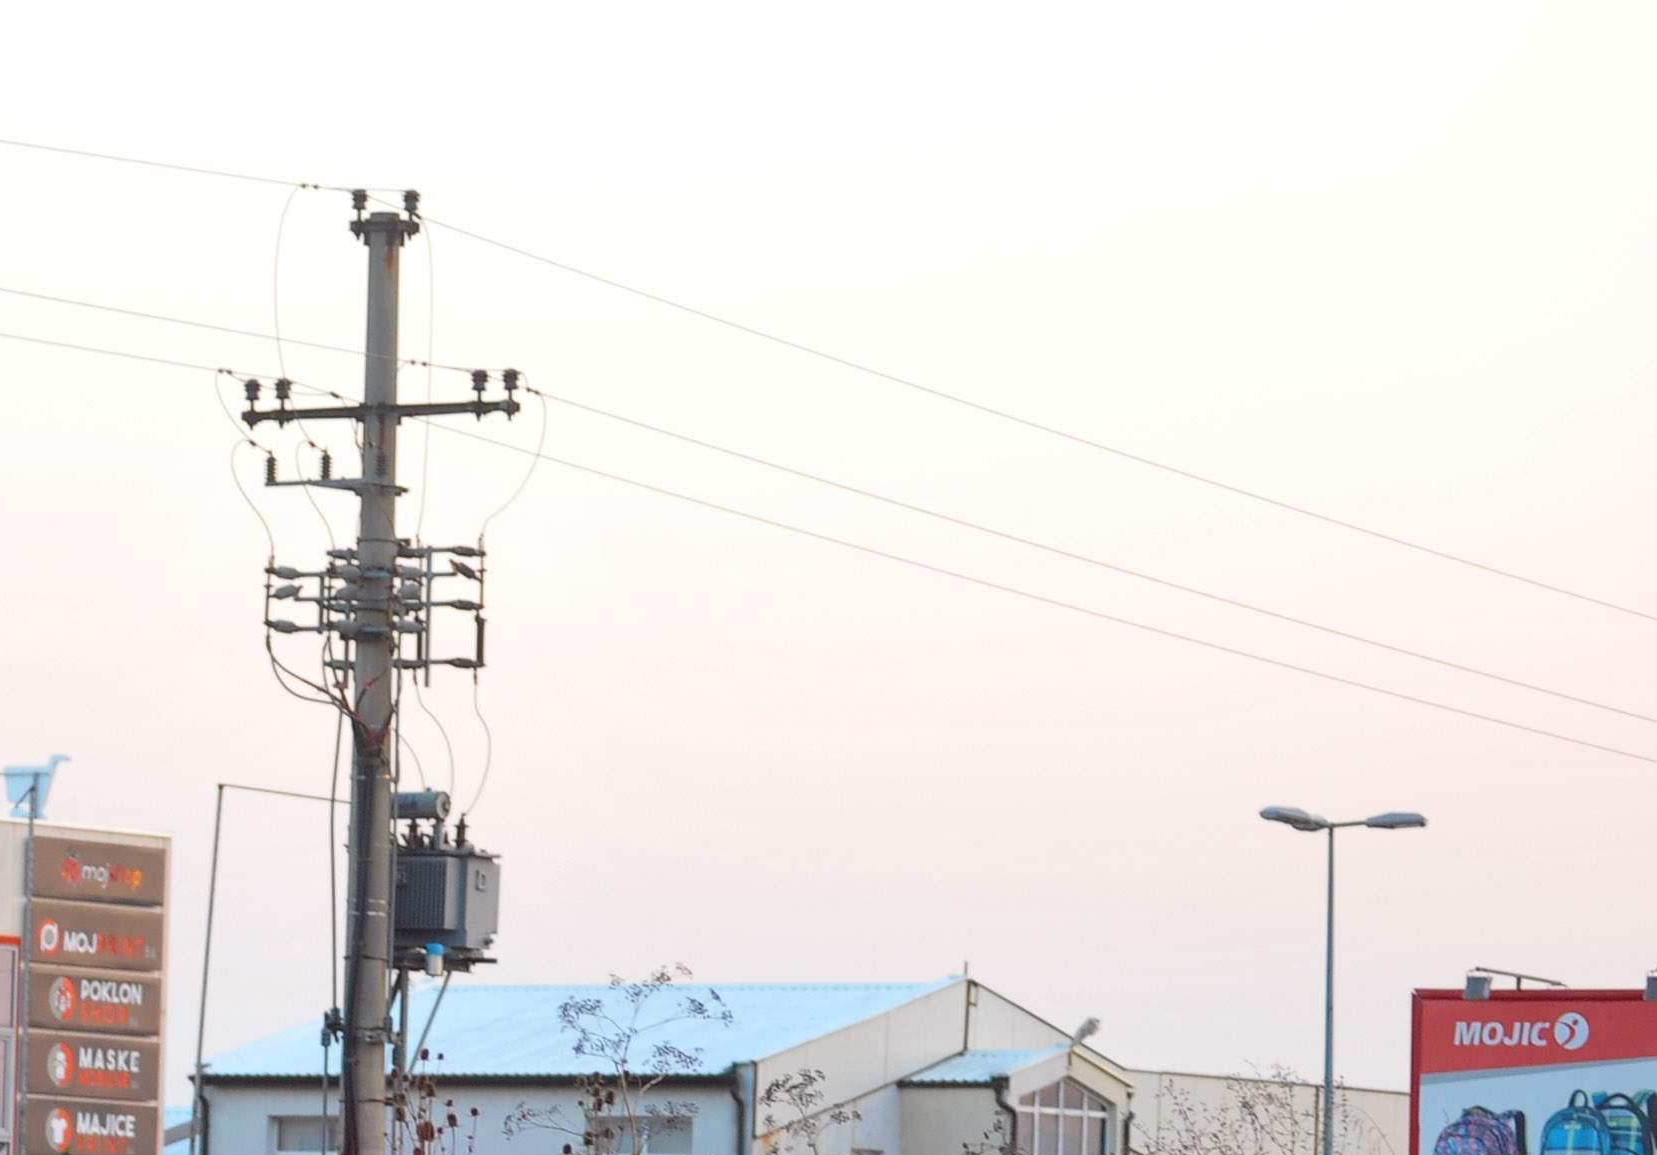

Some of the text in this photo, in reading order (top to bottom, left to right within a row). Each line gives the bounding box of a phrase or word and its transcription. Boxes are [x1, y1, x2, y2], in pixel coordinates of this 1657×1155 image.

[80, 979, 143, 1005] POKLON
[1453, 1020, 1550, 1046] MOJIC
[78, 1047, 141, 1073] MASKE
[76, 1111, 136, 1138] MAJICE
